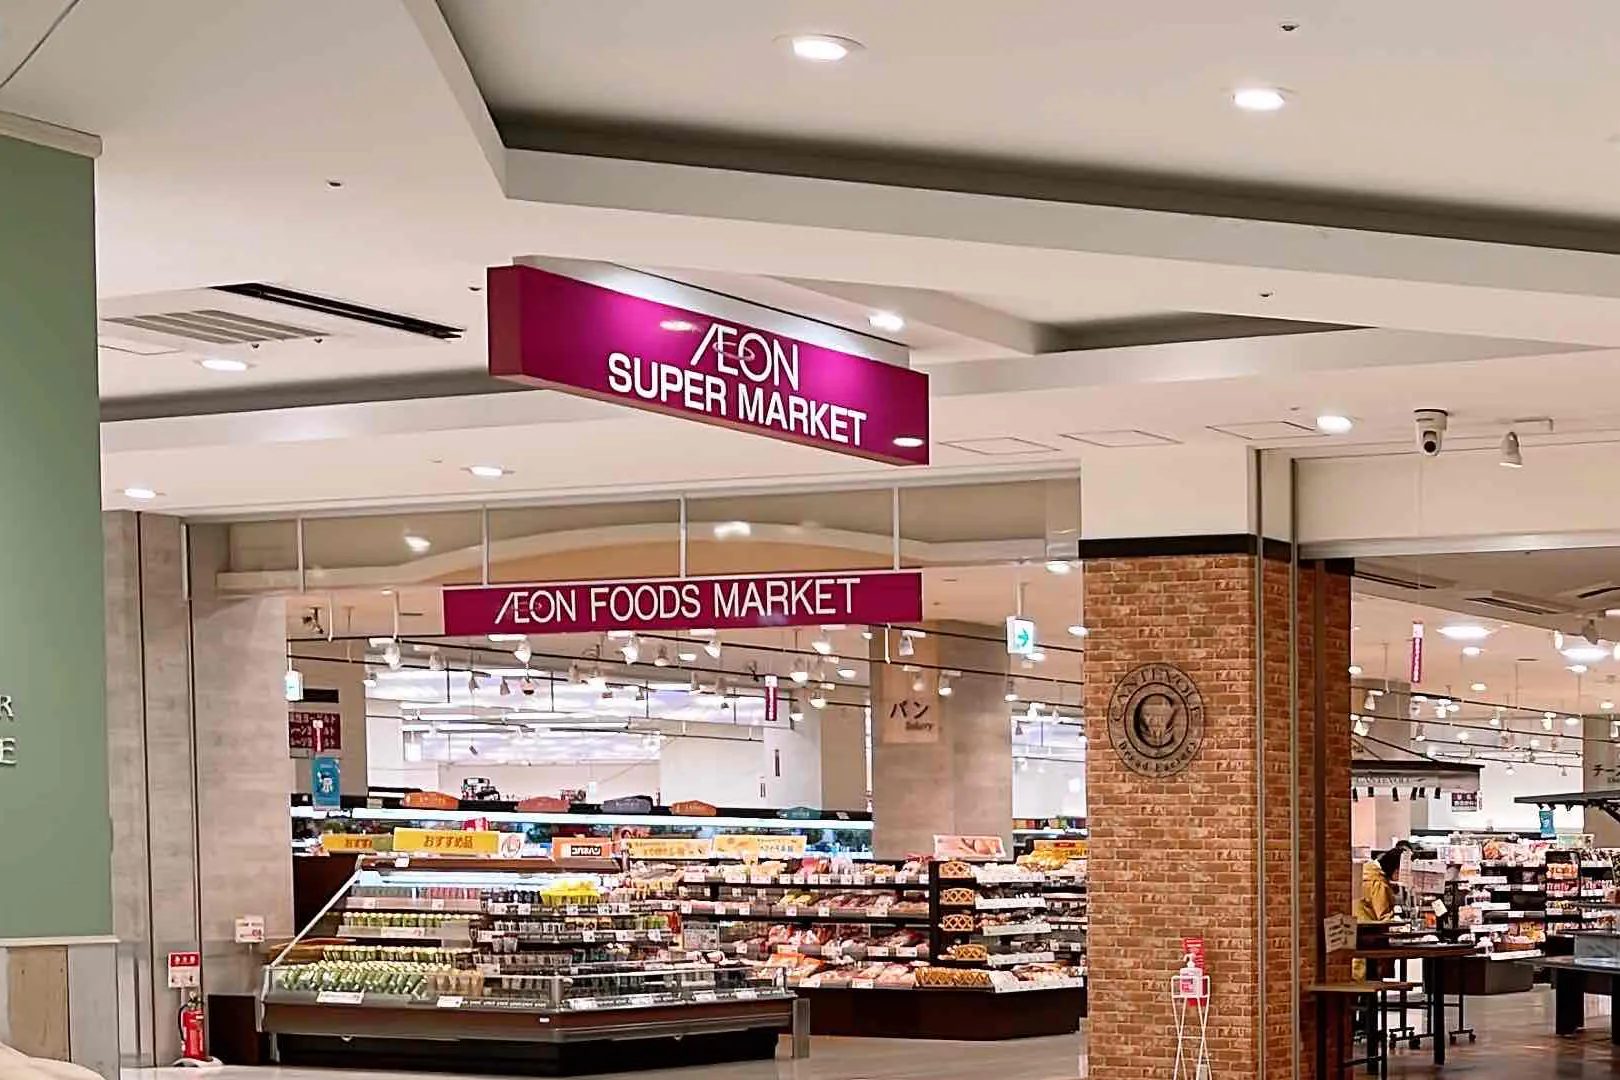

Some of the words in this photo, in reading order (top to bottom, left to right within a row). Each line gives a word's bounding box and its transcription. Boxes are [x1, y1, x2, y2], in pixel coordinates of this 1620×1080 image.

[608, 352, 727, 416] SUPER
[738, 383, 867, 446] MARKET
[591, 585, 700, 622] FOODS
[714, 577, 861, 618] MARKET
[890, 700, 928, 719] パン
[423, 834, 473, 850] おすすめ品
